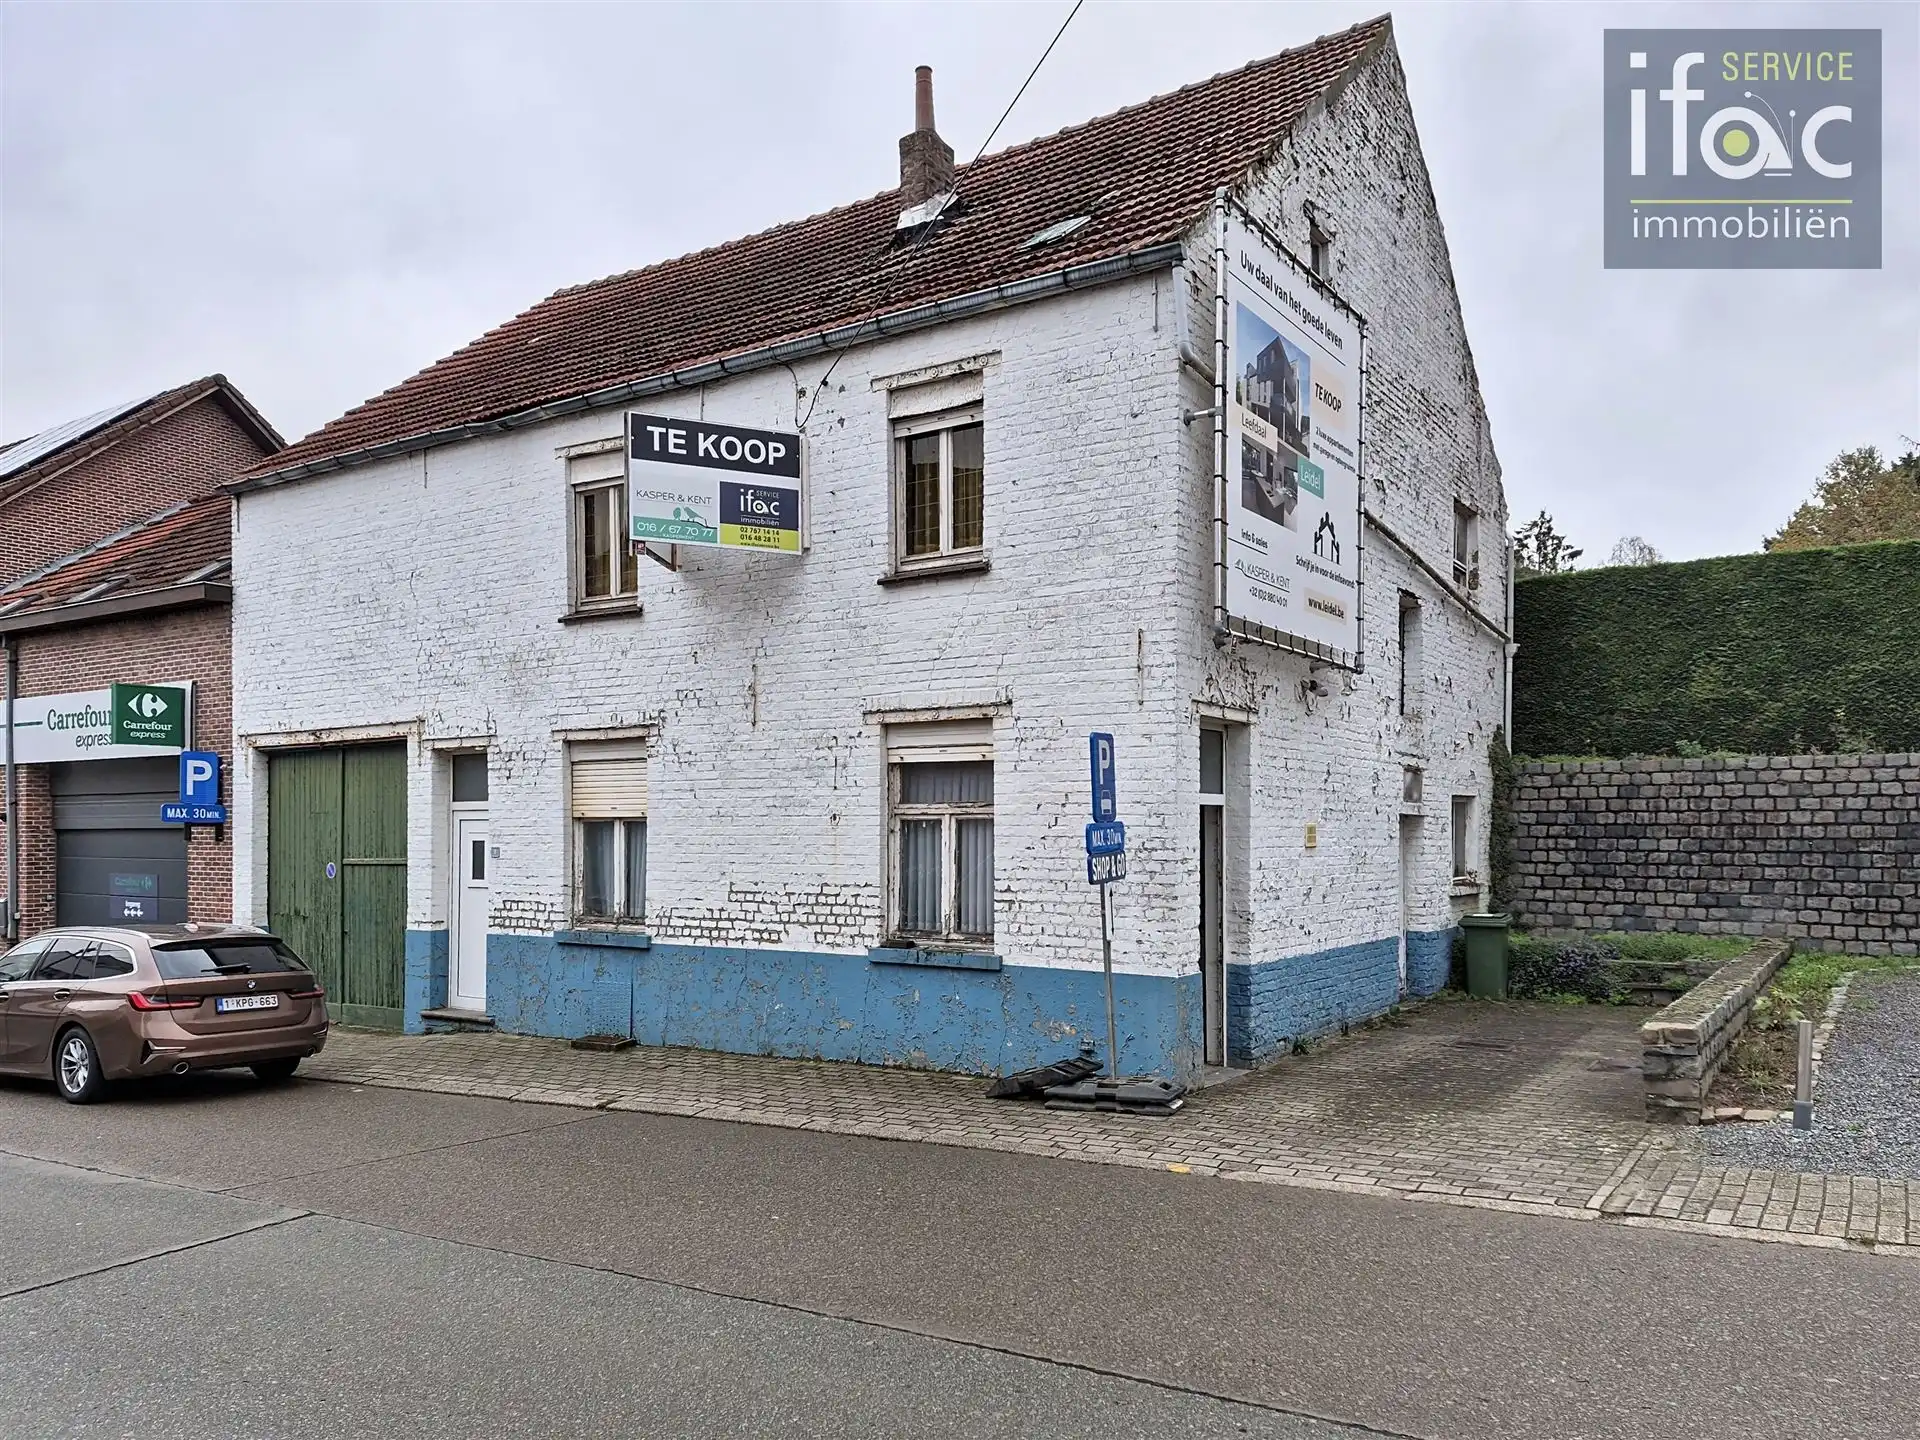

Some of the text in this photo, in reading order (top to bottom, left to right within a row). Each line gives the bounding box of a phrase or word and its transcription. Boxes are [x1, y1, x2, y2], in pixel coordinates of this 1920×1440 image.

[1240, 249, 1343, 350] Uw daal van het goede leven
[1314, 382, 1342, 413] TE KOOP
[1241, 412, 1267, 439] Leefdaal
[646, 425, 786, 466] TE KOOP
[1300, 464, 1320, 490] Leidel
[636, 489, 713, 505] KASPER & KENT
[740, 488, 780, 515] ifac
[756, 489, 780, 499] SERVICE
[637, 521, 657, 532] 016
[669, 525, 682, 534] 67
[685, 526, 699, 536] 70
[702, 528, 714, 537] 77
[1247, 563, 1270, 581] KASPER
[1276, 575, 1290, 589] KENT
[1308, 597, 1344, 619] www.leidel.be
[123, 719, 173, 731] Carrefour
[130, 731, 166, 740] express
[1098, 739, 1110, 785] P
[186, 759, 213, 796] P
[166, 807, 190, 819] MAX.
[1092, 853, 1126, 881] SHOP & GO
